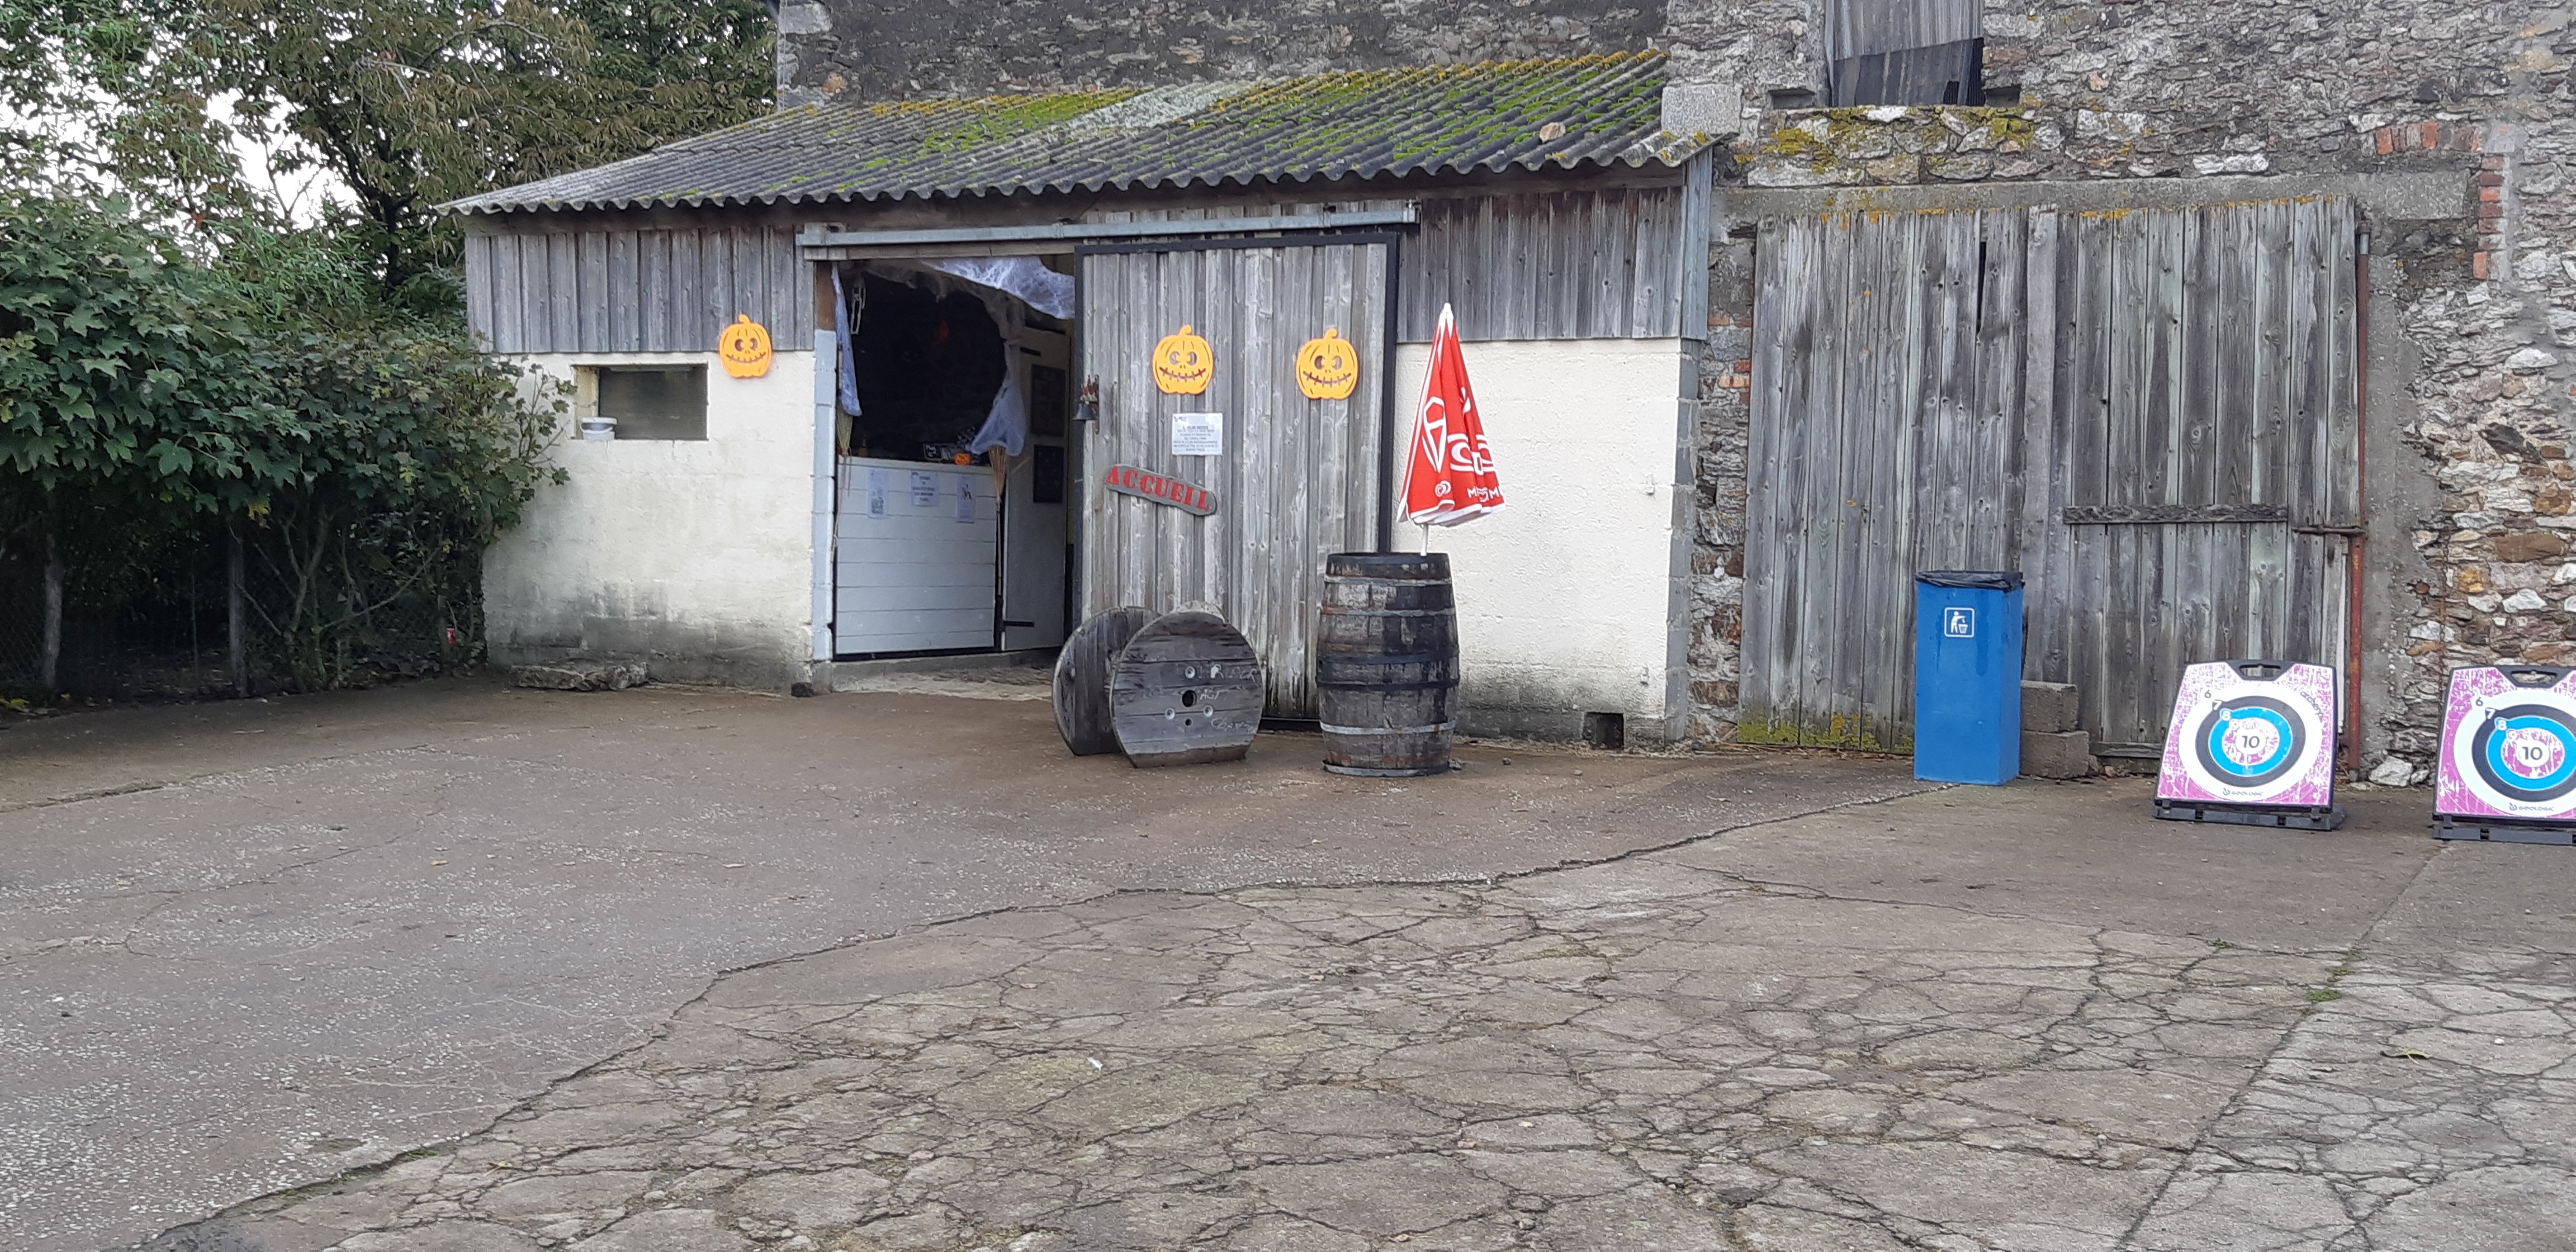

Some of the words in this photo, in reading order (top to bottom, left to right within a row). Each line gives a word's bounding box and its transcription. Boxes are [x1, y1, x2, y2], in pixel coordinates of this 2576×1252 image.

[1106, 466, 1212, 511] ACCUEIL
[2204, 689, 2212, 698] 6
[2213, 700, 2222, 710] 7
[2475, 696, 2484, 706] 6
[2222, 710, 2231, 721] 8
[2485, 708, 2496, 719] 7
[2497, 719, 2507, 731] 8
[2242, 736, 2260, 748] 10
[2508, 730, 2518, 743] 9
[2522, 746, 2543, 760] 10
